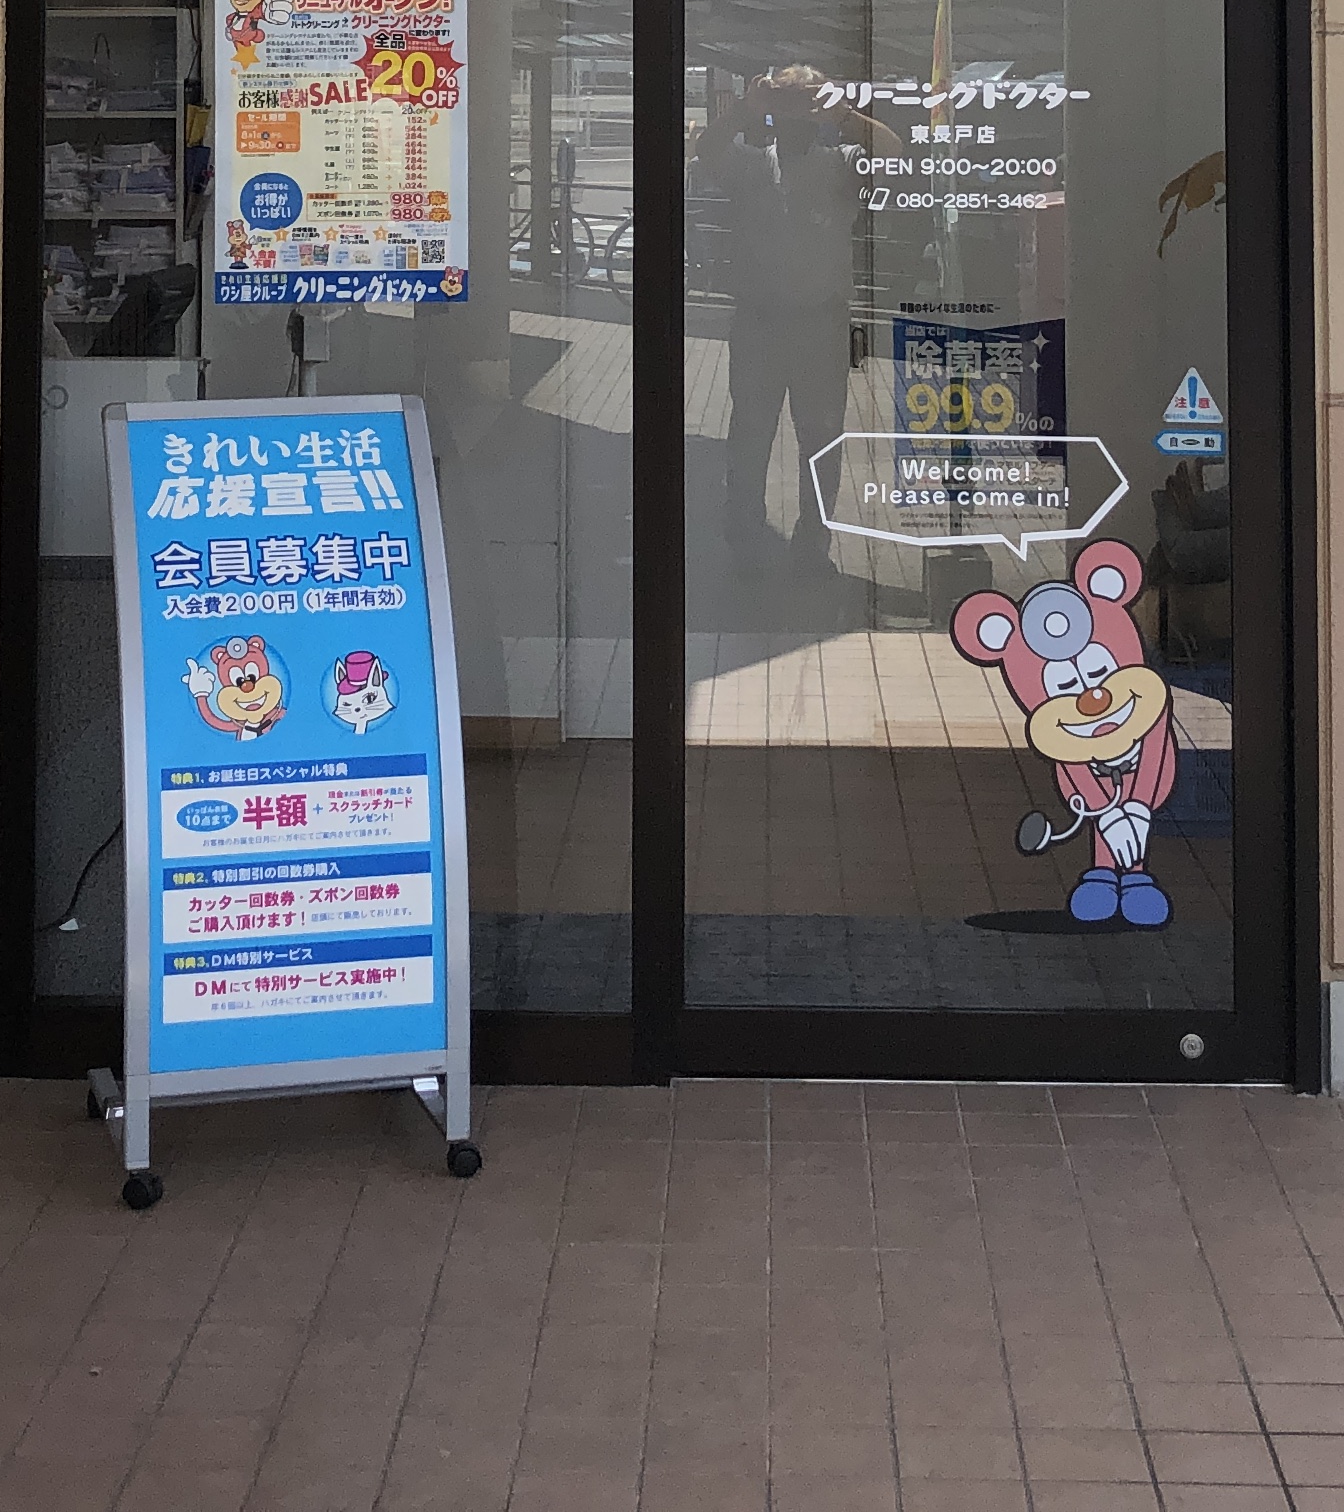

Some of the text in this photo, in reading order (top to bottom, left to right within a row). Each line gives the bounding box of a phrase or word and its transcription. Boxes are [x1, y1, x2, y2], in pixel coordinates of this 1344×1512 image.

[375, 33, 405, 49] 全品
[422, 90, 458, 107] OFF
[815, 80, 1091, 110] クリーニングドクター
[910, 125, 997, 145] 東長戸店
[856, 157, 913, 176] OPEN
[254, 193, 288, 206] お得が
[896, 192, 1048, 210] 080-2851-3462
[251, 207, 291, 219] いっぱい
[292, 273, 438, 303] クリーニングドクター
[905, 340, 1024, 379] 除菌率
[162, 427, 382, 475] きれい生活
[902, 459, 1031, 481] Welcome!
[147, 469, 405, 520] 応援宣言!!
[863, 483, 1070, 508] Please come in!
[153, 531, 411, 590] 会員募集中
[242, 794, 307, 830] 半額
[329, 796, 413, 813] スクラッチカード
[184, 814, 231, 827] 10点まで
[349, 813, 393, 824] プレゼント!
